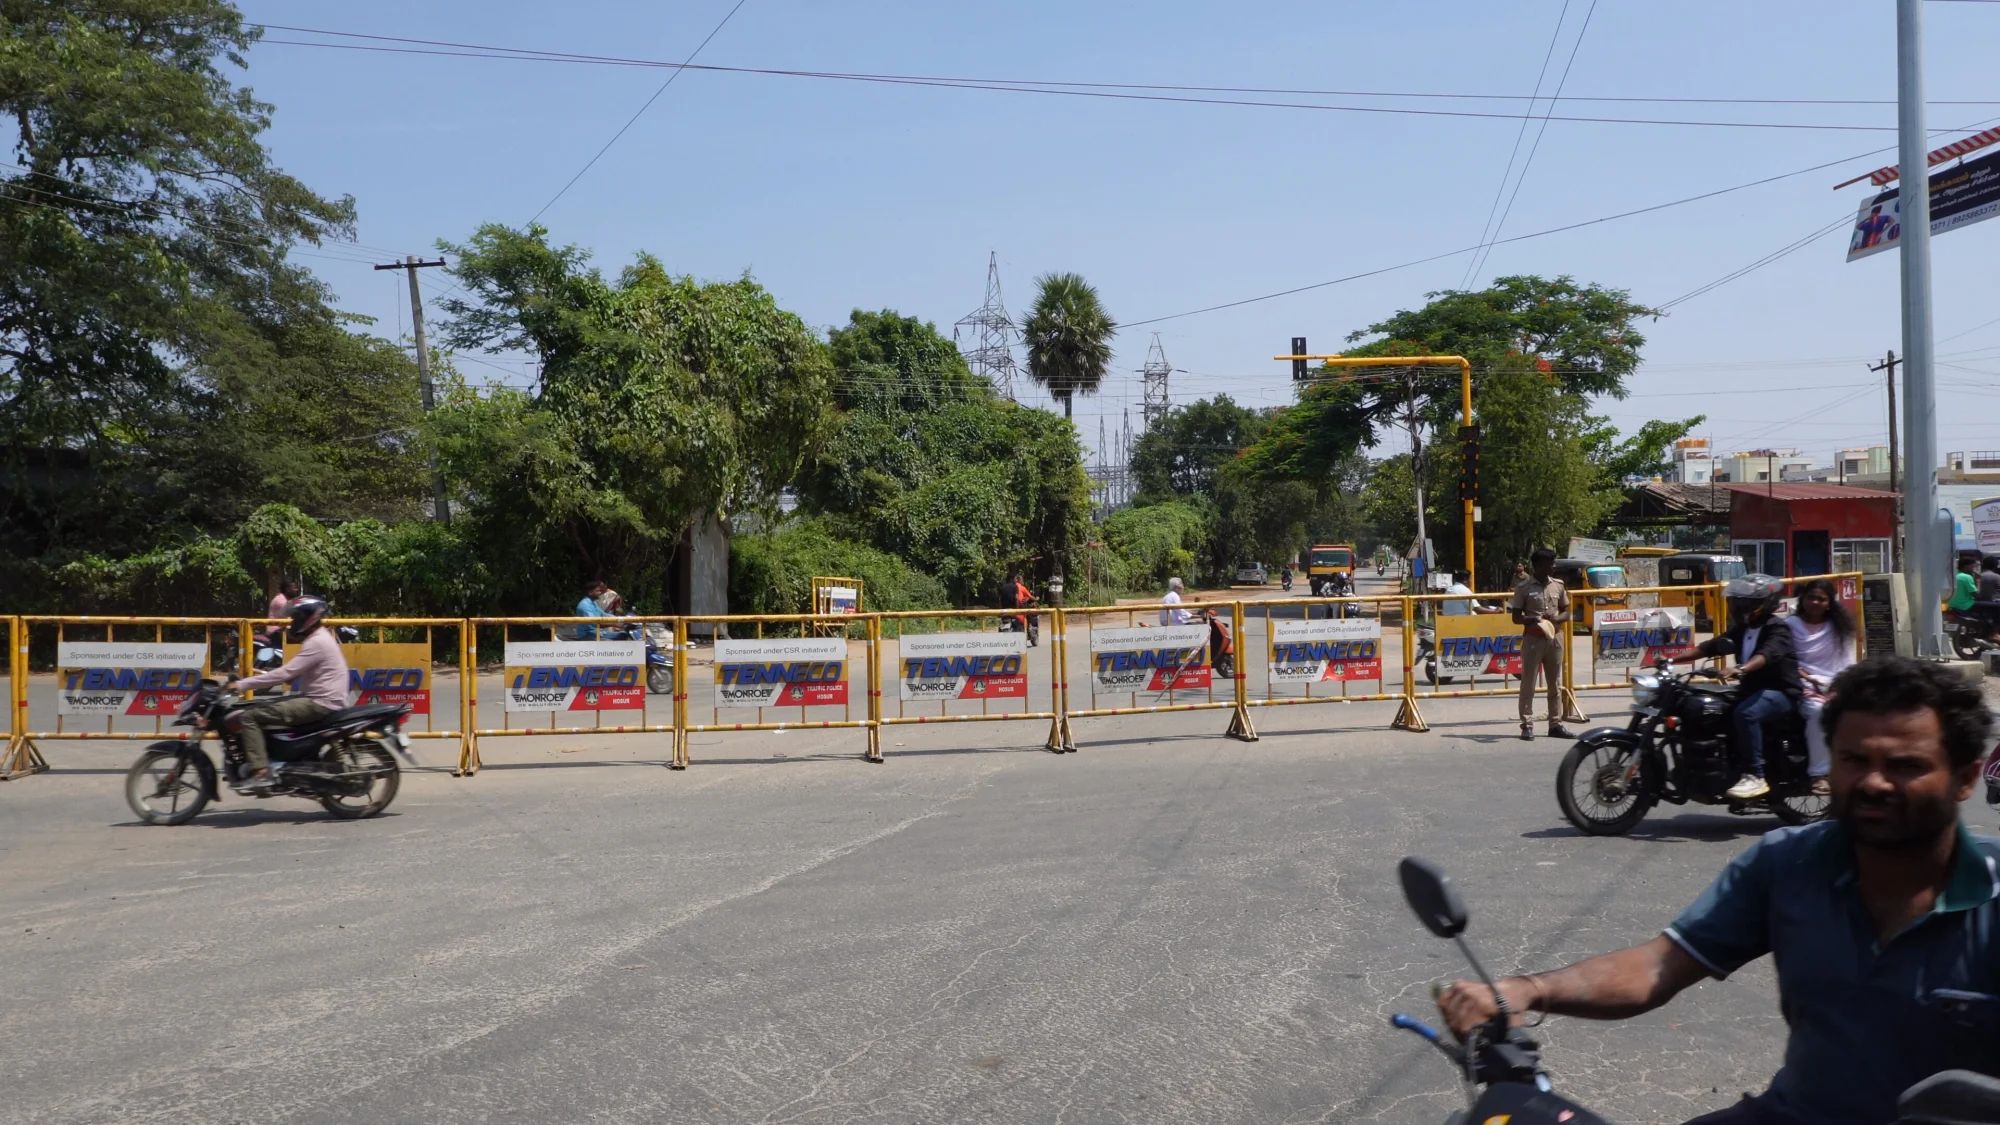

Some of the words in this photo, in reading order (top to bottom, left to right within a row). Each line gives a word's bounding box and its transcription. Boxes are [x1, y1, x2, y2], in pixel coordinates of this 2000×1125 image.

[1612, 610, 1636, 621] PARKING
[1277, 628, 1308, 636] Sponsored
[1101, 636, 1134, 644] Sponsored
[784, 646, 800, 654] CSR
[1274, 640, 1377, 662] TENNECO
[1441, 636, 1523, 656] TENNEC
[70, 652, 111, 660] Sponsored
[112, 652, 134, 660] under
[136, 652, 154, 660] CSR
[578, 650, 595, 658] CSR
[596, 650, 625, 658] initiative
[1097, 646, 1206, 672] TENNECO
[1605, 652, 1635, 660] MONROE
[905, 654, 1022, 678] TENNECO
[1447, 660, 1479, 668] MONROE
[720, 662, 842, 685] TENNECO
[1280, 666, 1314, 675] MONROE
[65, 667, 202, 690] TENNECO
[1106, 674, 1140, 684] MONROE
[913, 683, 951, 692] MONROE
[520, 692, 561, 702] MONROE
[727, 688, 768, 698] MONROE
[72, 696, 118, 706] MONROE
